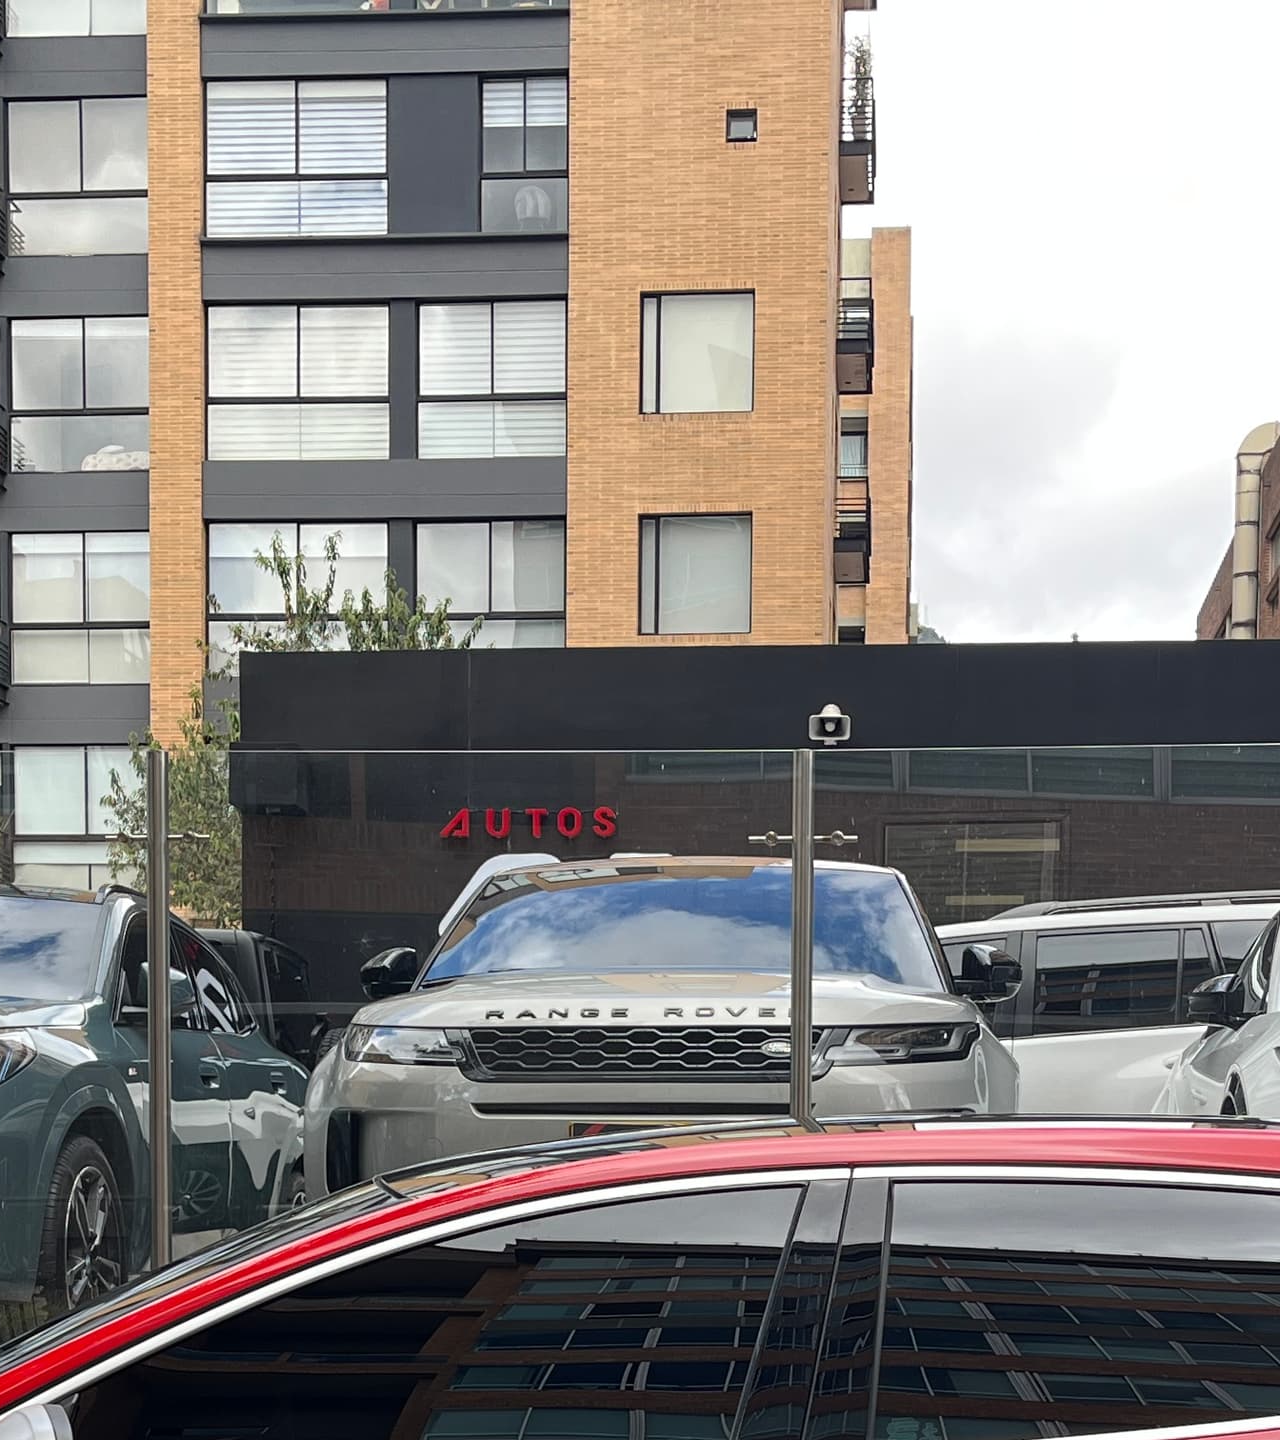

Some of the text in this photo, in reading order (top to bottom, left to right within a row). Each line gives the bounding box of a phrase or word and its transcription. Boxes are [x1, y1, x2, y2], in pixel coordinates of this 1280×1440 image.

[439, 806, 617, 839] AUTOS
[485, 1007, 791, 1020] RANGE ROVE
